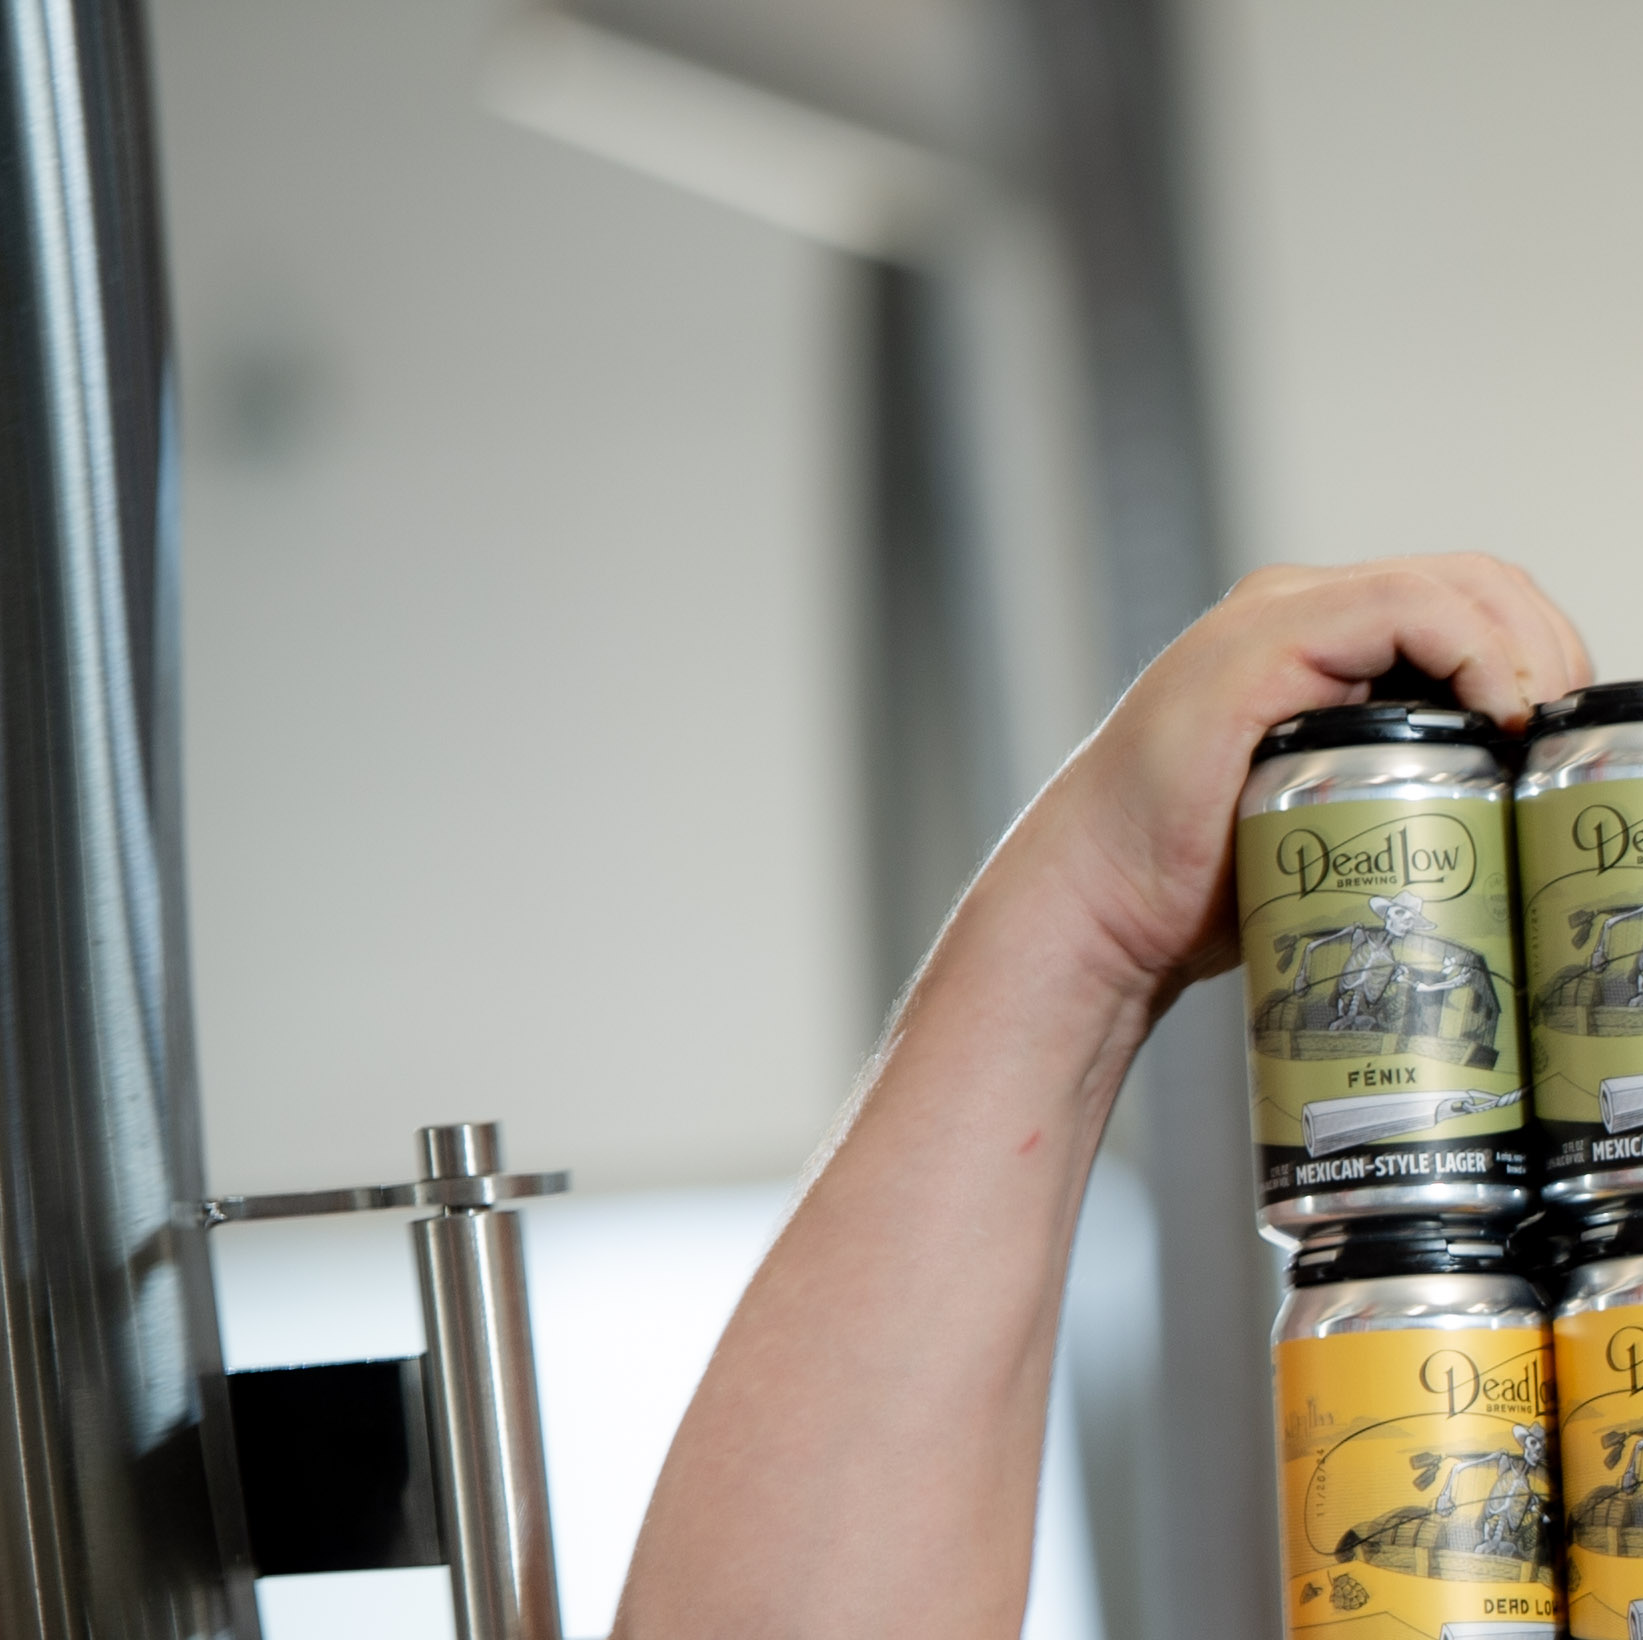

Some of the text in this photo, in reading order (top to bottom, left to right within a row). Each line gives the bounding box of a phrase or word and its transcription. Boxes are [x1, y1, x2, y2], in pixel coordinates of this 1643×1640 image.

[1277, 826, 1460, 899] Dead Low
[1336, 876, 1398, 888] BREWING
[1347, 1062, 1417, 1088] FÉNIX
[1296, 1152, 1431, 1186] MEXICAN-STYLE
[1435, 1152, 1486, 1173] LAGER
[1419, 1349, 1530, 1419] Dead
[1486, 1403, 1533, 1414] BREWING
[1484, 1598, 1530, 1614] DEAD
